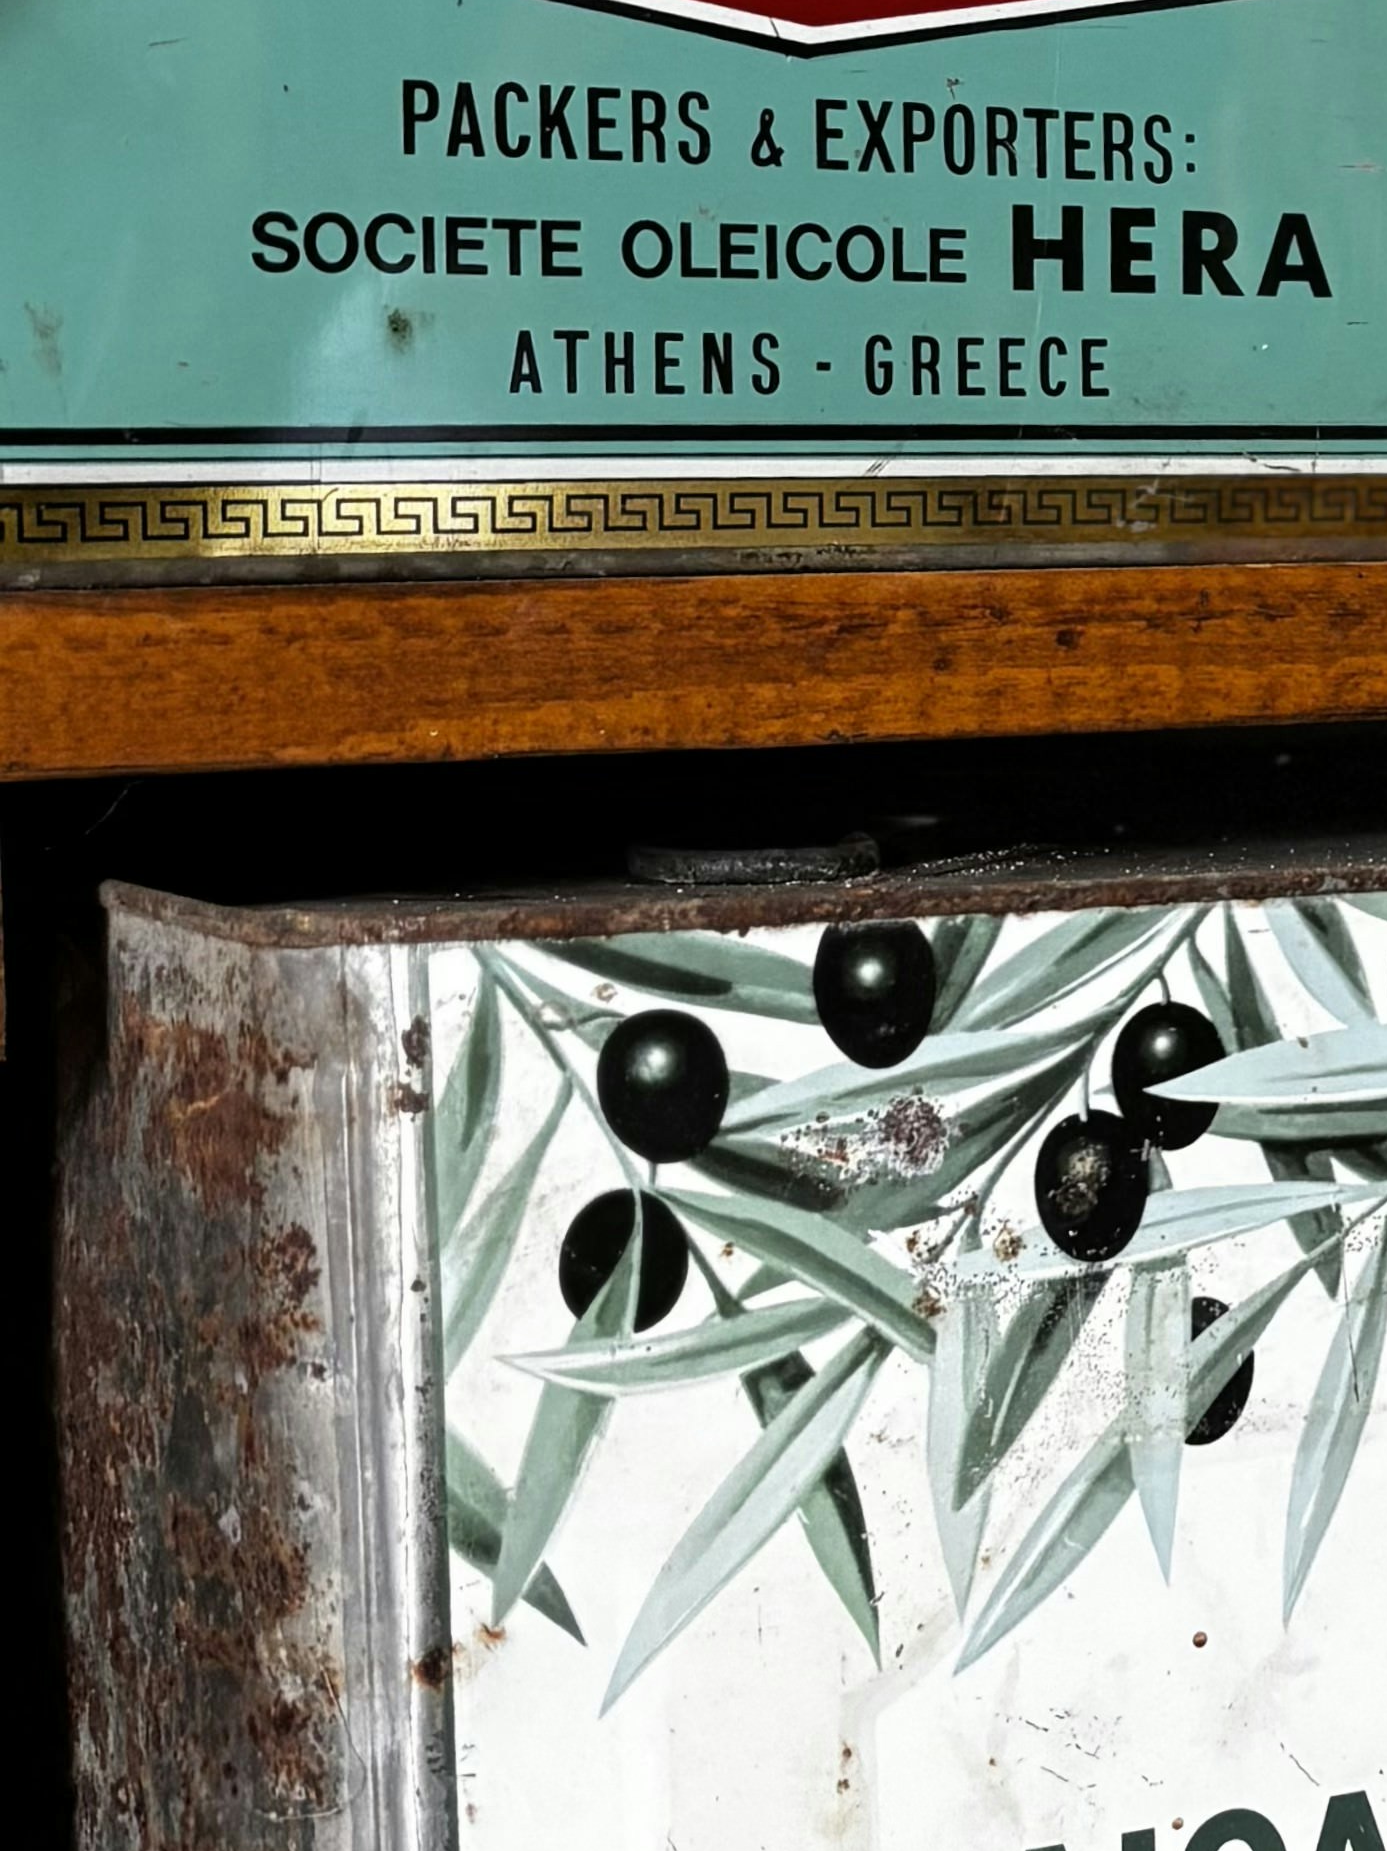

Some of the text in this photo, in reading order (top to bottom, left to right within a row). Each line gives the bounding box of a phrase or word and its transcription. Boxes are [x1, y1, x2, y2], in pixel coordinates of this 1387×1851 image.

[402, 80, 1198, 184] PACKERS & EXPORTERS:
[251, 205, 1333, 299] SOCIETE OLEICOLE HERA
[510, 330, 781, 396] ATHENS
[866, 336, 1110, 399] GREECE
